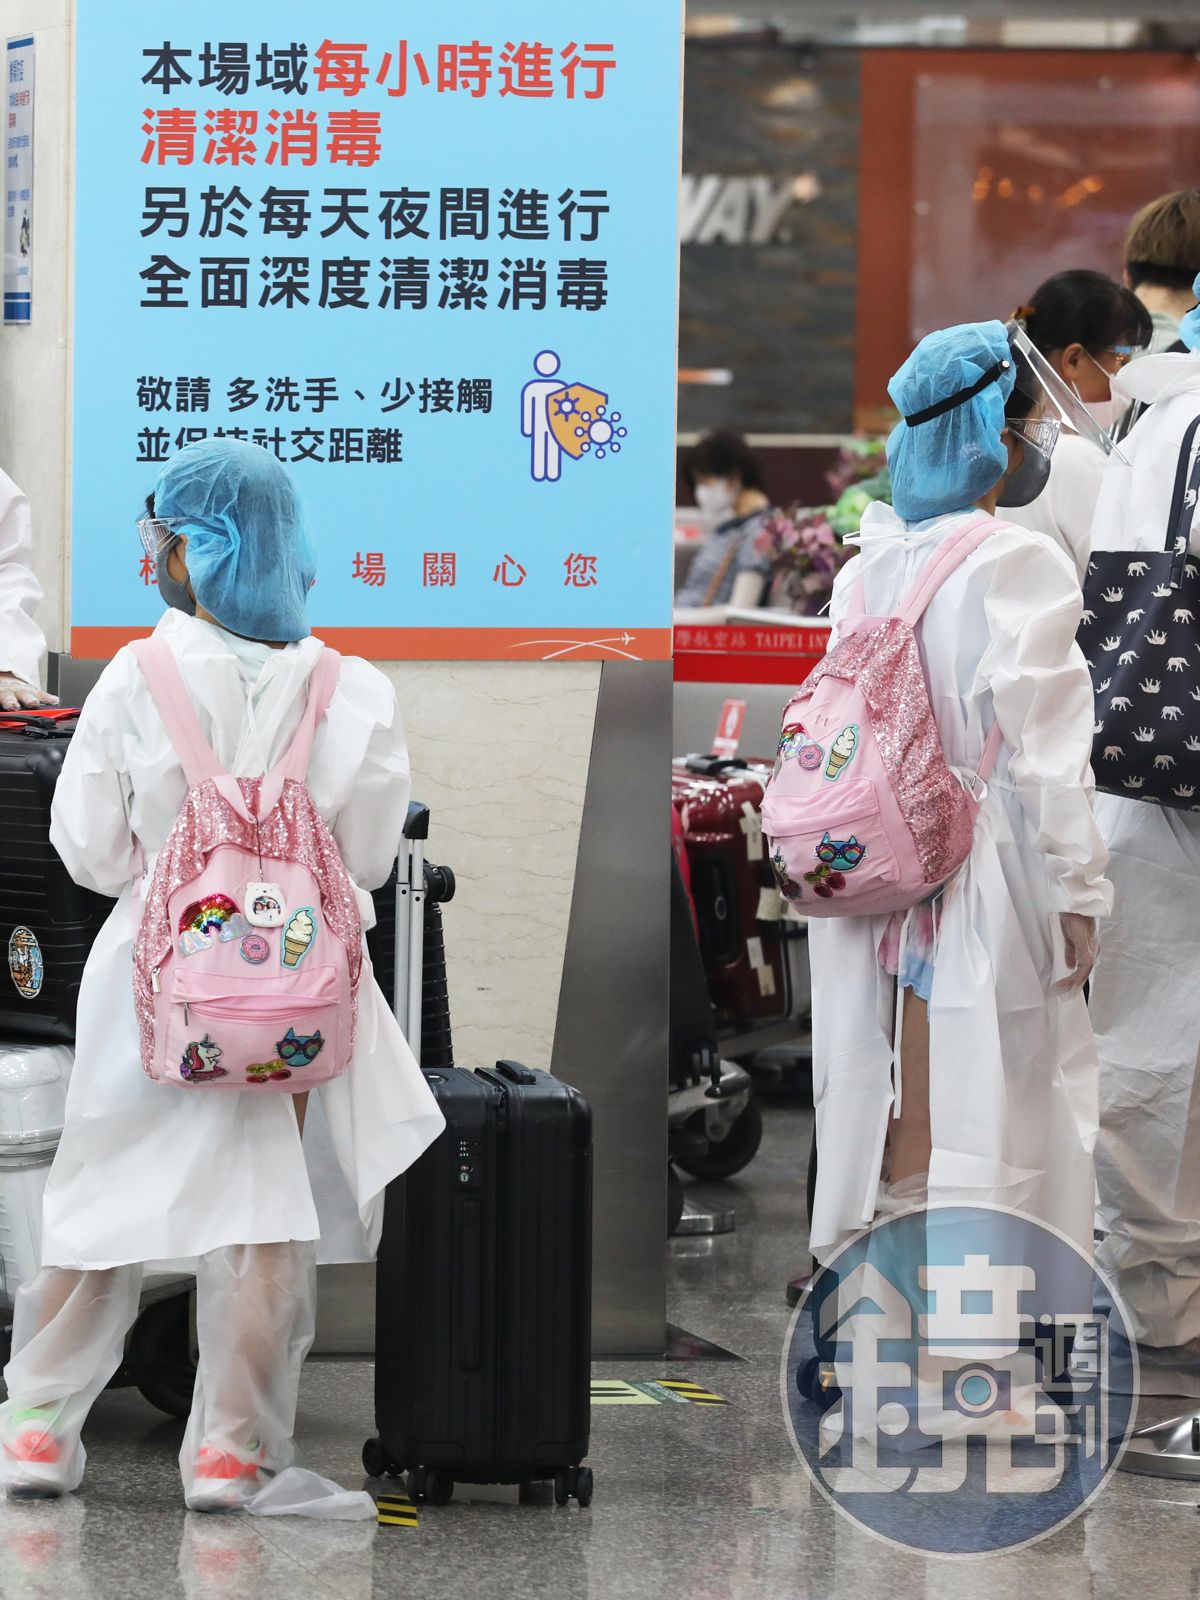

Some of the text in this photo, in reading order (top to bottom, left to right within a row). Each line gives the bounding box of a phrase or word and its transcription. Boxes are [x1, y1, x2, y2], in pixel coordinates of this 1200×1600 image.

[140, 39, 617, 100] 本場域每小時進行
[140, 107, 382, 167] 清潔消毒
[139, 184, 610, 242] 另於每天夜間進行
[138, 254, 609, 311] 全面深度清潔消毒
[136, 375, 494, 416] 敬請 多洗手、少接觸
